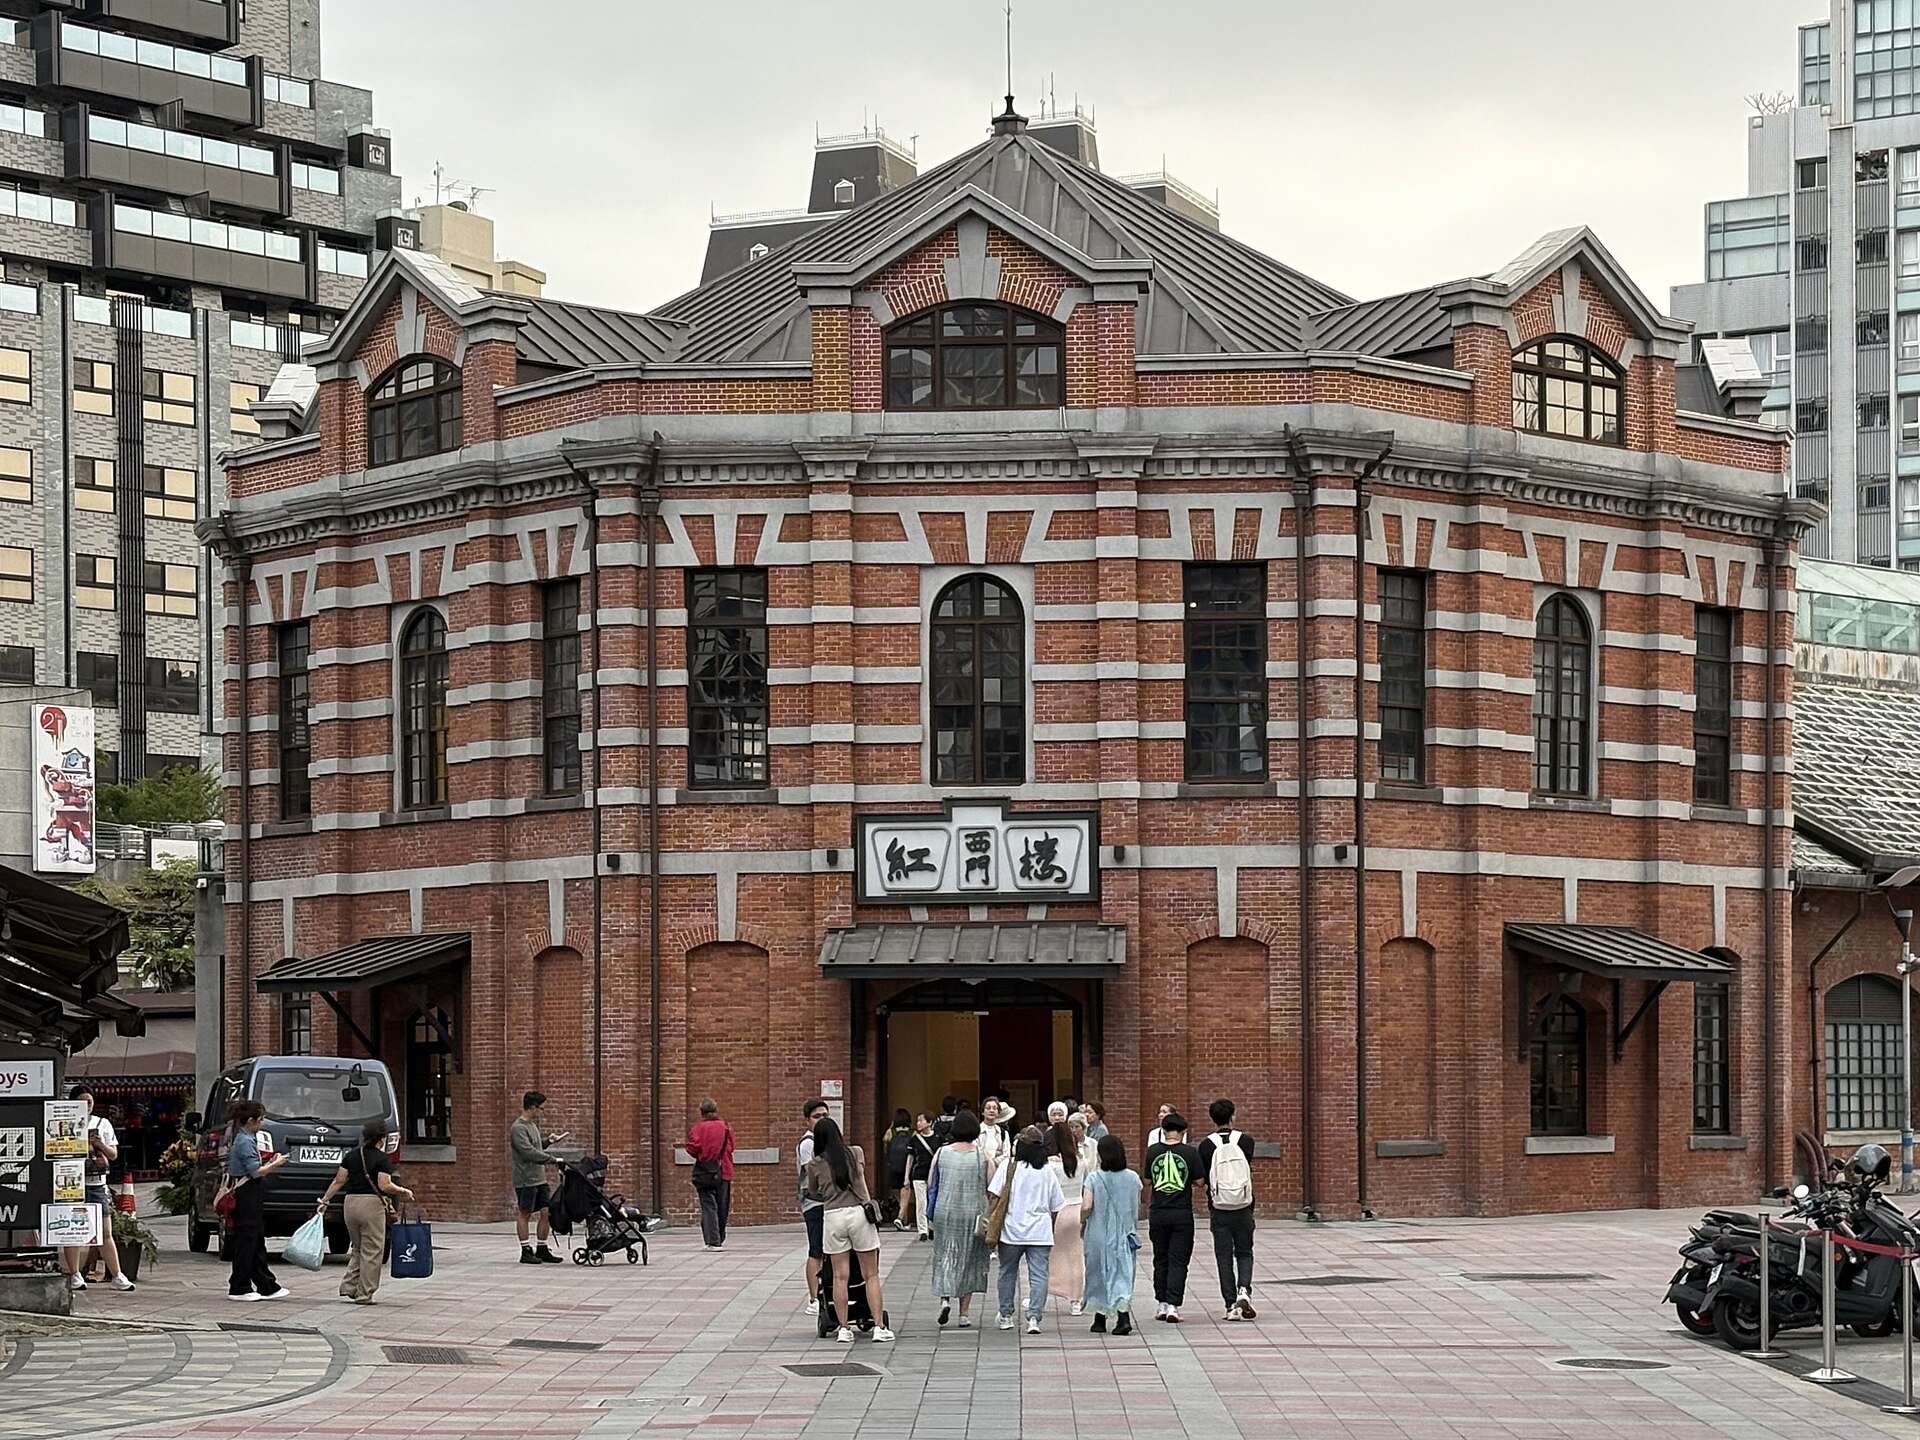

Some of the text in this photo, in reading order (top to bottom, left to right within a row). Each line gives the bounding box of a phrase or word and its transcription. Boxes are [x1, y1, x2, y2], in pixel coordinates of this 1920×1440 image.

[885, 837, 937, 882] 紅
[965, 831, 991, 885] 西門
[301, 1149, 341, 1160] AXX-3527
